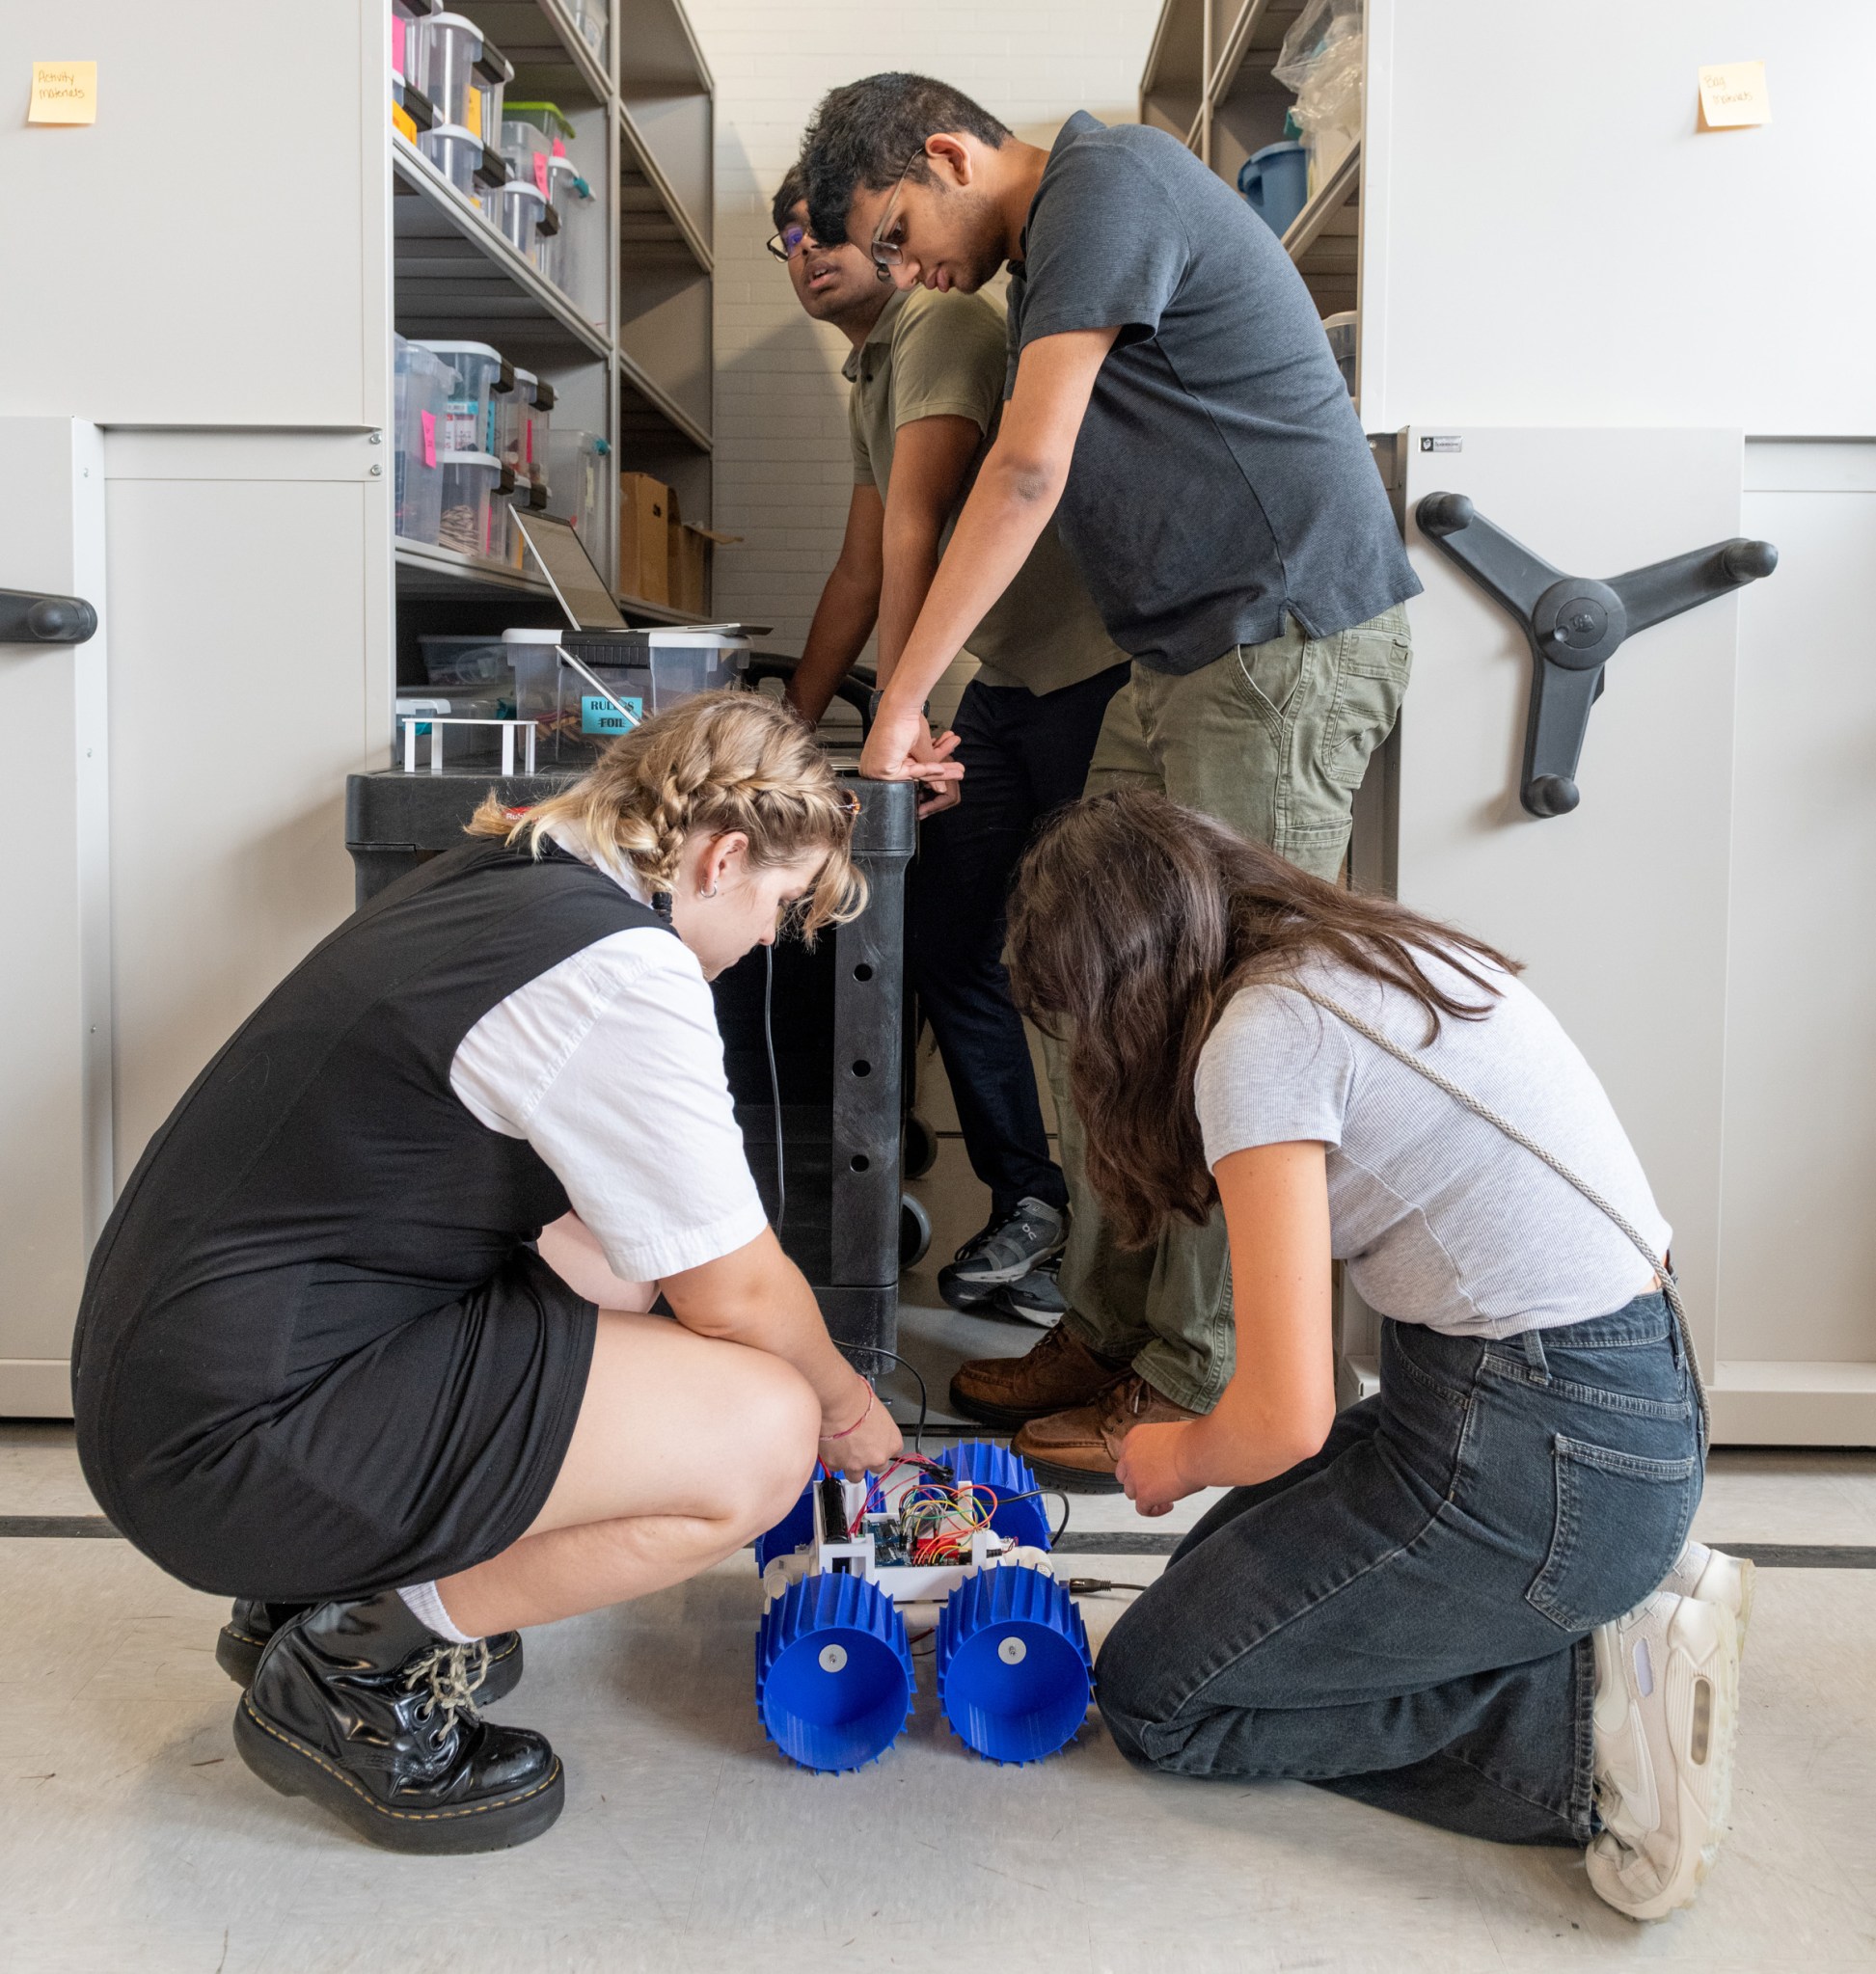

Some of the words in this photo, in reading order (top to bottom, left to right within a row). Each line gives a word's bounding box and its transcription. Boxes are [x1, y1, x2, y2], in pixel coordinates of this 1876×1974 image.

[39, 69, 74, 87] Activity
[590, 700, 634, 712] RULS
[600, 717, 625, 728] FOIL
